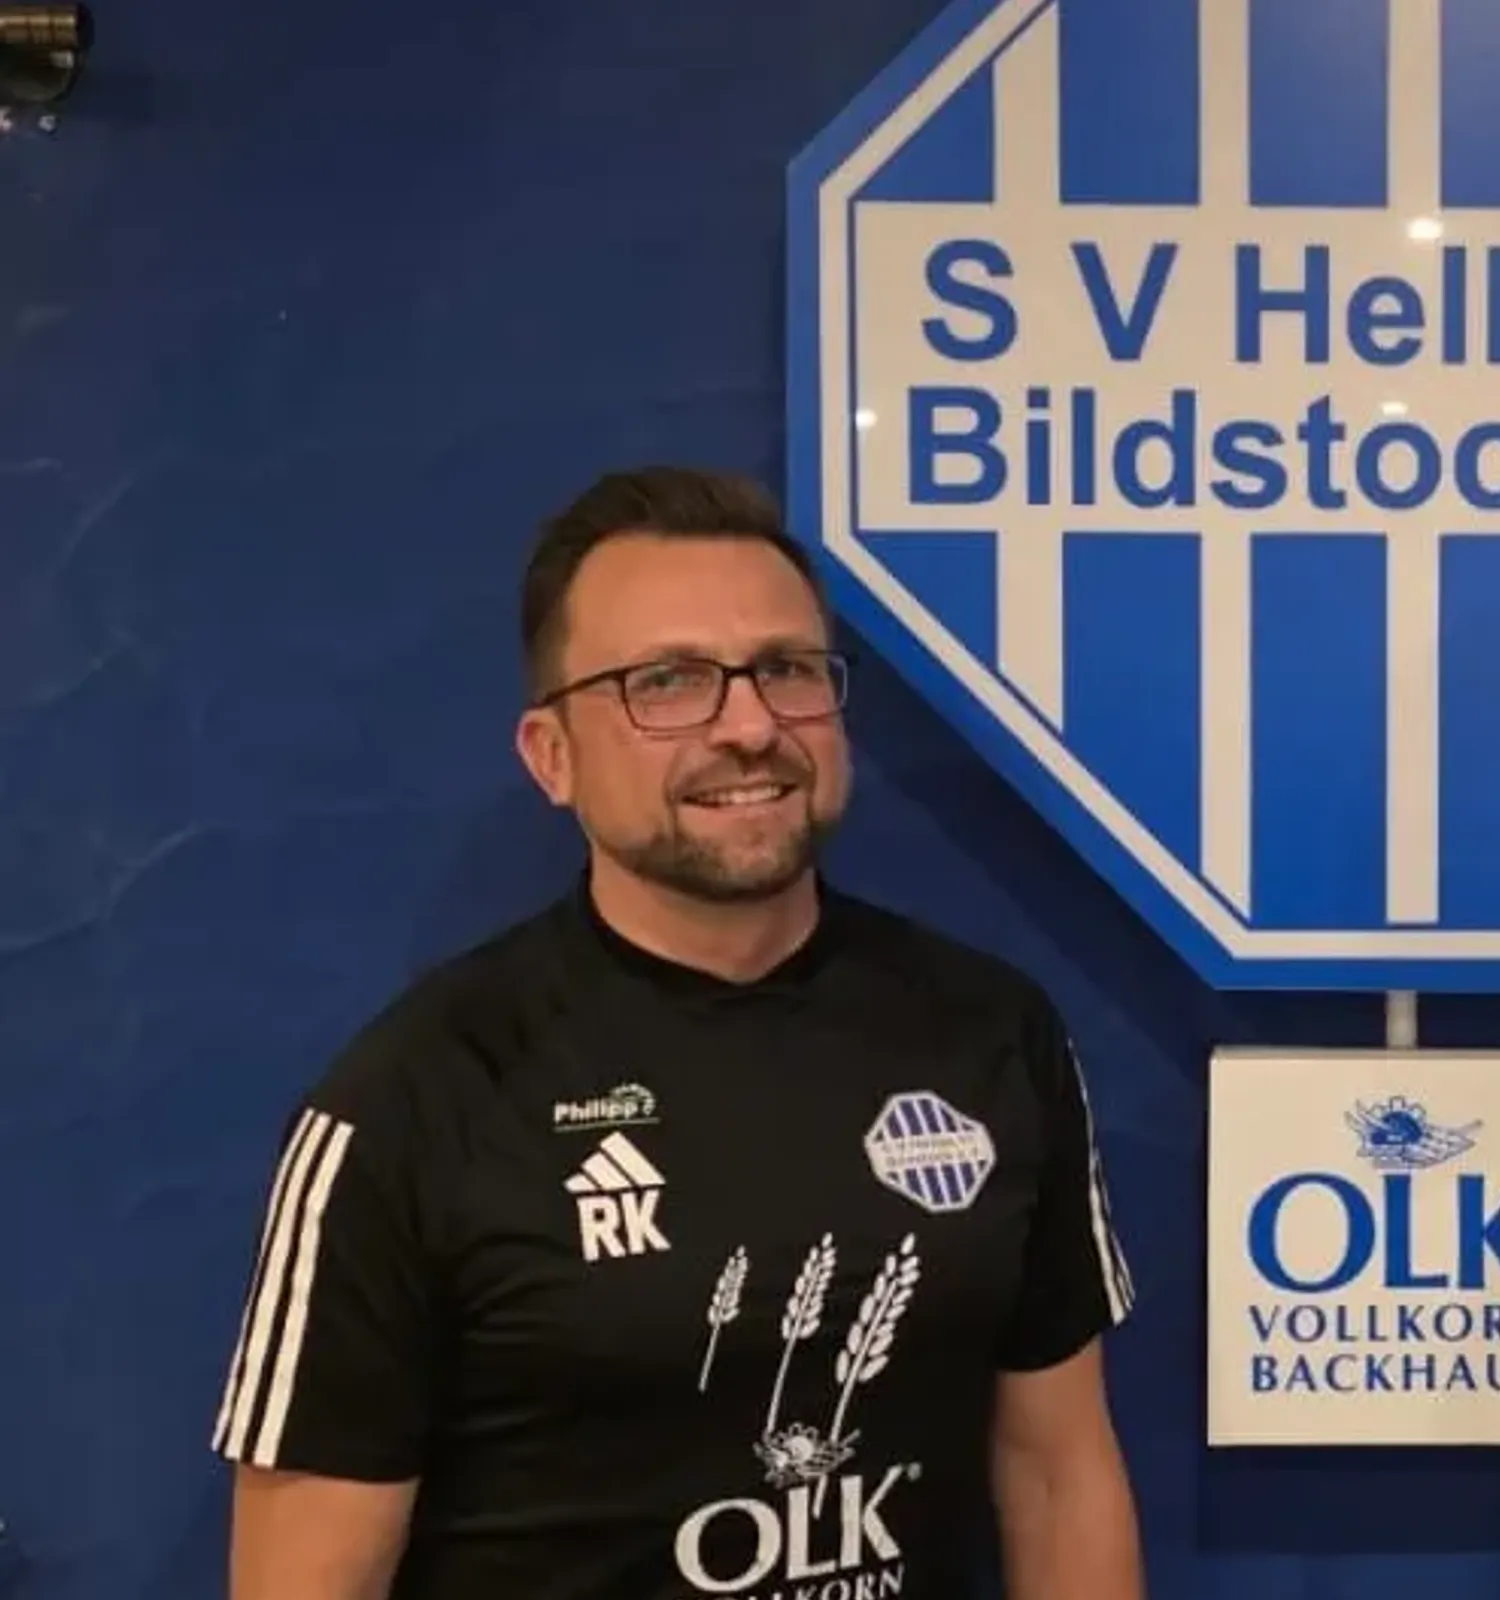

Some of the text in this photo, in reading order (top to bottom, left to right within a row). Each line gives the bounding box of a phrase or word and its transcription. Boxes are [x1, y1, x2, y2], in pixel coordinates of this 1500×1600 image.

[920, 239, 1018, 362] S
[1071, 241, 1178, 361] V
[576, 1187, 671, 1262] RK
